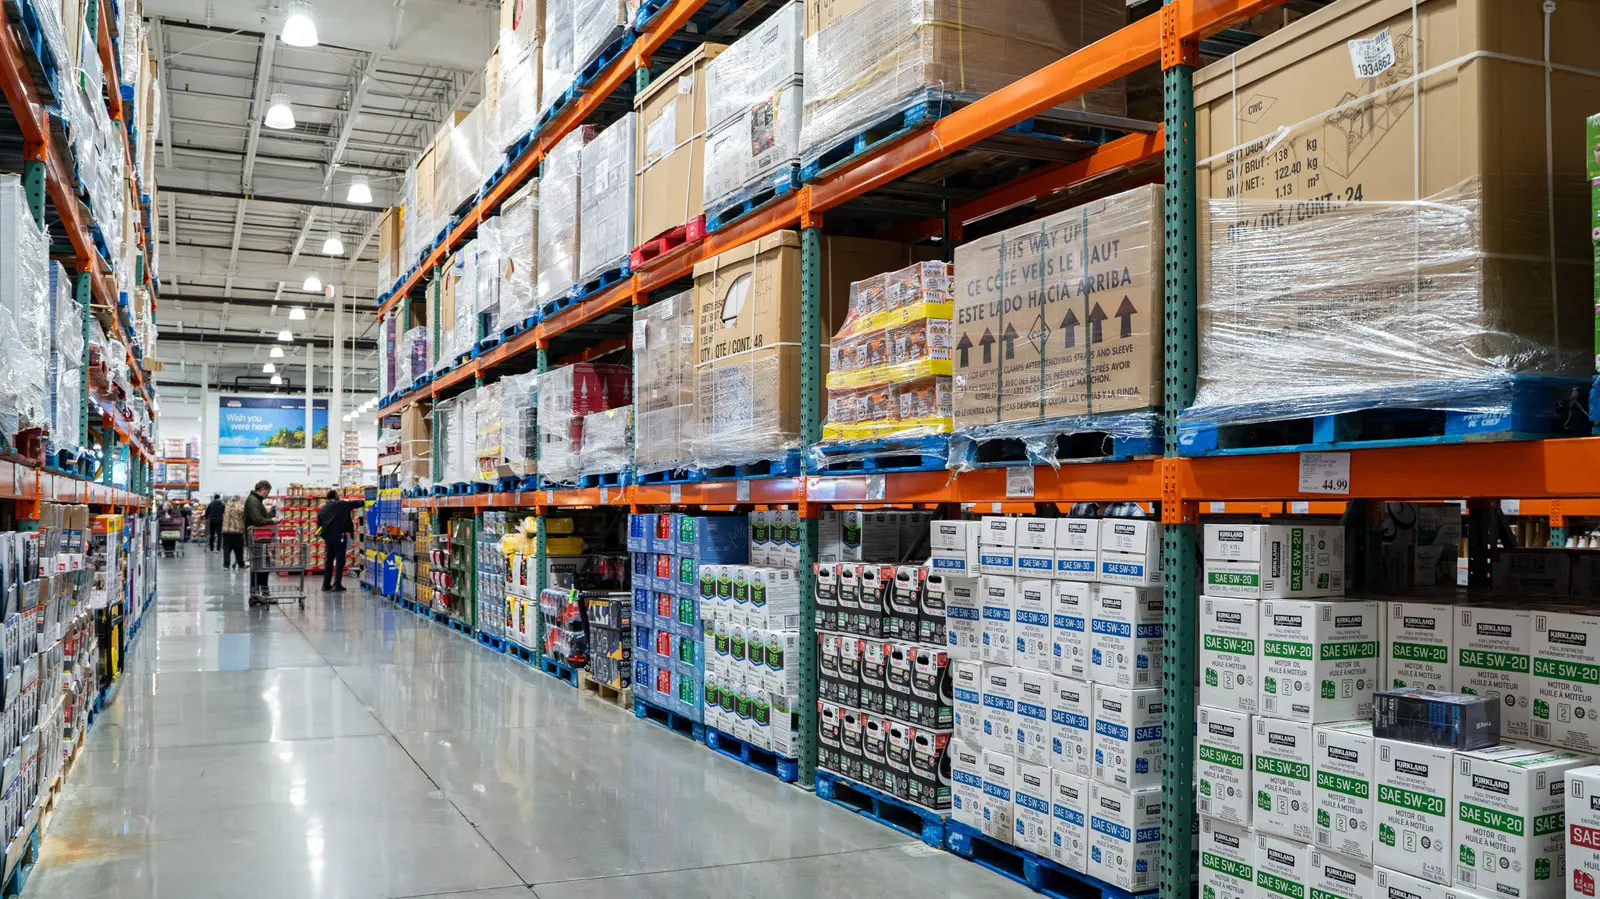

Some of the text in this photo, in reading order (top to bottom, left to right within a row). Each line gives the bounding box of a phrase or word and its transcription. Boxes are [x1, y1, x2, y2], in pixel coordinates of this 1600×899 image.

[1358, 54, 1391, 75] 1934862
[1248, 101, 1263, 115] CWC
[1274, 148, 1288, 163] 138
[1306, 138, 1317, 151] kg
[1245, 175, 1260, 191] NET
[1275, 161, 1302, 181] 122.40
[1307, 157, 1318, 170] kg
[1275, 183, 1292, 199] 1.13
[1345, 183, 1363, 207] 24
[1030, 230, 1058, 254] WAY
[1063, 223, 1082, 243] UP
[968, 279, 981, 297] CE
[987, 264, 1016, 289] CÔTÉ
[1060, 253, 1073, 273] LE
[959, 266, 1131, 325] ESTE LADO HACIA ARRIBA
[701, 347, 710, 362] QTY
[754, 334, 763, 348] 48
[1004, 365, 1024, 373] CLAMPS
[1096, 349, 1110, 358] AND
[1112, 344, 1133, 355] SLEEVE
[1005, 379, 1017, 387] AVEC
[1019, 377, 1028, 385] DES
[1111, 361, 1130, 371] AVOIR
[1077, 375, 1111, 386] MACHON.
[962, 408, 984, 416] LEVANTAR
[1069, 394, 1078, 403] LAS
[227, 413, 245, 421] Wish
[252, 423, 272, 431] here?
[1322, 480, 1348, 490] 44.99
[1108, 563, 1137, 574] SAE 5W-30
[1215, 574, 1252, 584] SAE 5W-20
[1293, 572, 1301, 590] SAE
[1018, 611, 1047, 624] SAE 5W-30
[1093, 620, 1130, 635] SAE 5W-30
[1138, 626, 1152, 635] SAE
[1478, 625, 1510, 633] KIRKLAND
[1550, 631, 1585, 640] KIRKLAND
[1206, 637, 1252, 652] SAE 5W-20
[1265, 643, 1312, 657] SAE 5W-20
[1323, 644, 1374, 657] SAE 5W-20
[1394, 646, 1446, 659] SAE 5W-20
[1462, 651, 1527, 669] SAE 5W-20
[1535, 661, 1598, 680] SAE 5W-20
[1548, 681, 1583, 692] MOTOR OIL
[1540, 688, 1557, 697] HUILE
[1564, 692, 1592, 703] MOTEUR
[1053, 711, 1087, 727] SAE 5W-30
[1096, 722, 1127, 738] SAE 5W-30
[1137, 729, 1153, 738] SAE
[1201, 748, 1242, 765] SAE 5W-20
[1330, 747, 1357, 758] KIRKLAND
[1258, 759, 1309, 777] SAE 5W-20
[1396, 760, 1427, 772] KIRKLAND
[1318, 774, 1368, 795] SAE 5W-20
[1474, 776, 1508, 790] KIRKLAND
[1017, 794, 1047, 812] SAE 5W-30
[1380, 787, 1443, 812] SAE 5W-20
[1395, 809, 1426, 823] MOTOR OIL
[1461, 806, 1522, 832] SAE 5W-20
[1092, 818, 1129, 840] SAE 5W-30
[1388, 816, 1404, 825] HUILE
[1410, 821, 1434, 833] MOTEUR
[1137, 832, 1152, 840] SAE
[1473, 827, 1508, 842] MOTOR OIL
[1465, 834, 1483, 845] HUILE
[1490, 840, 1516, 854] MOTEUR
[1203, 853, 1251, 879] SAE 5W-20
[1258, 874, 1303, 897] SAE 5W-20
